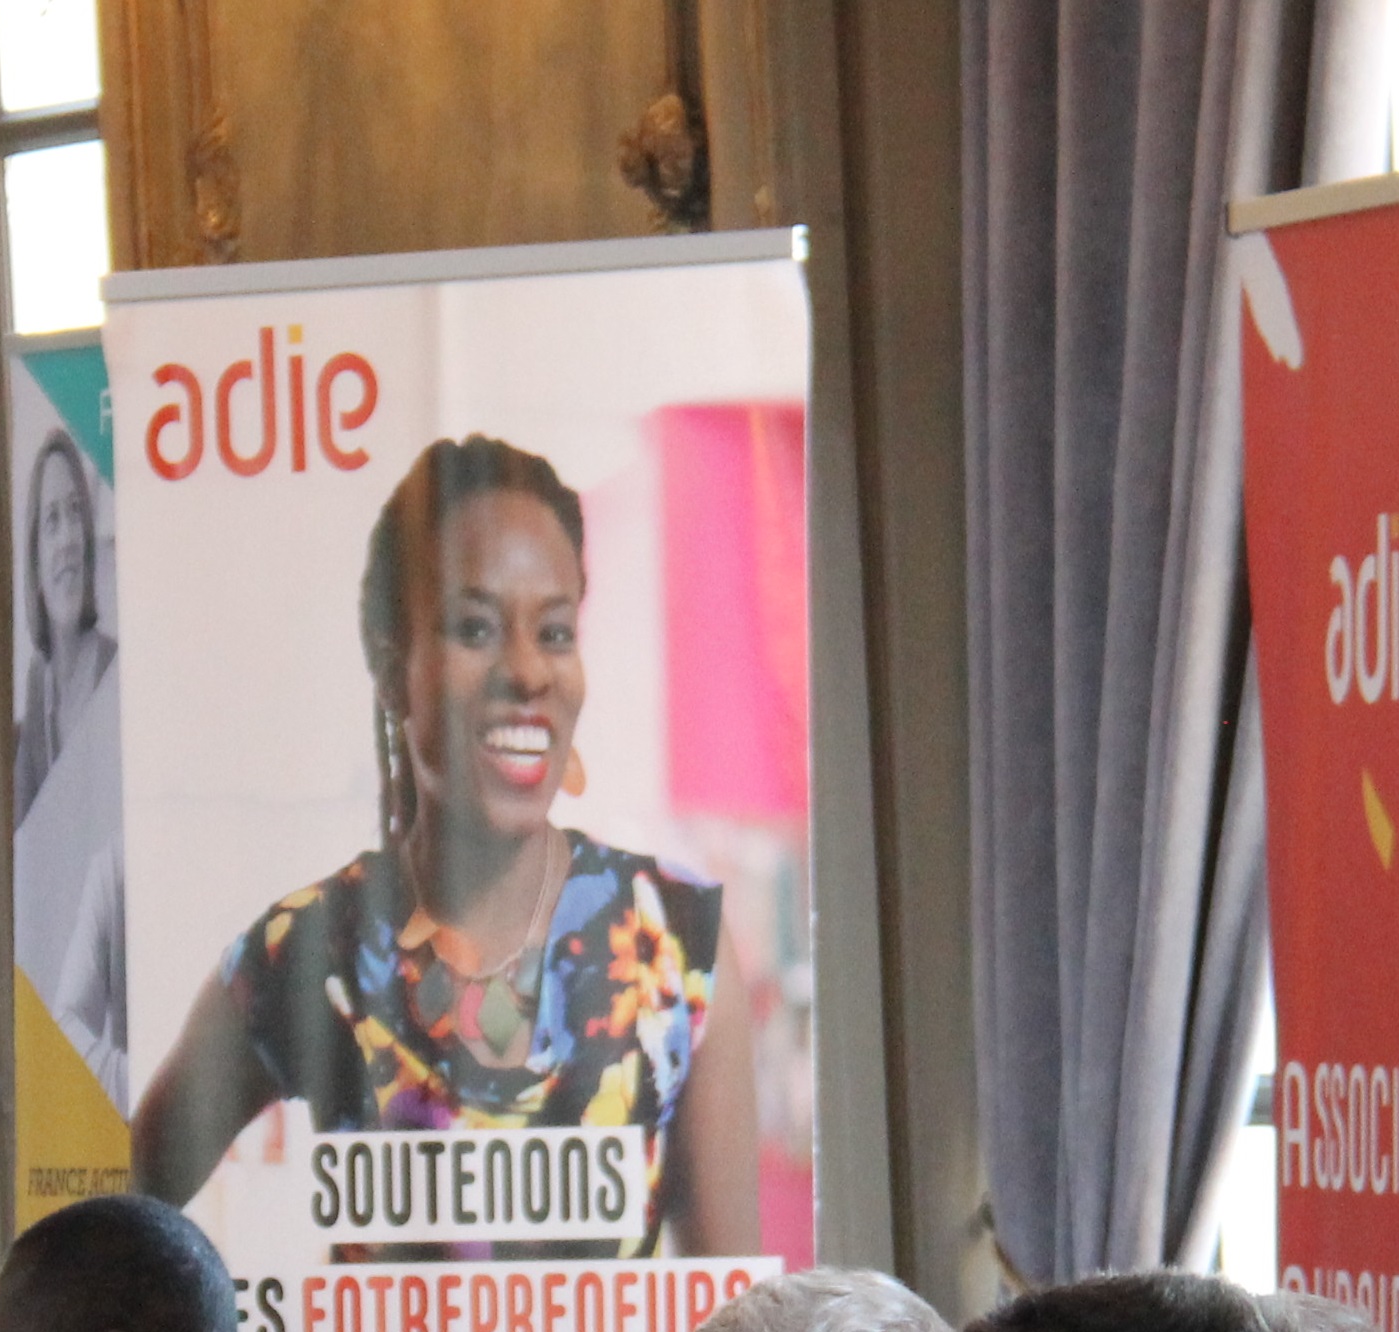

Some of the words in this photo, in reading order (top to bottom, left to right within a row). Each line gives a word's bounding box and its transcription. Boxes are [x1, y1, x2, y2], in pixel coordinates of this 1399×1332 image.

[145, 325, 378, 481] adie
[28, 1167, 87, 1196] FRANCE
[311, 1136, 627, 1227] SOUTENONS
